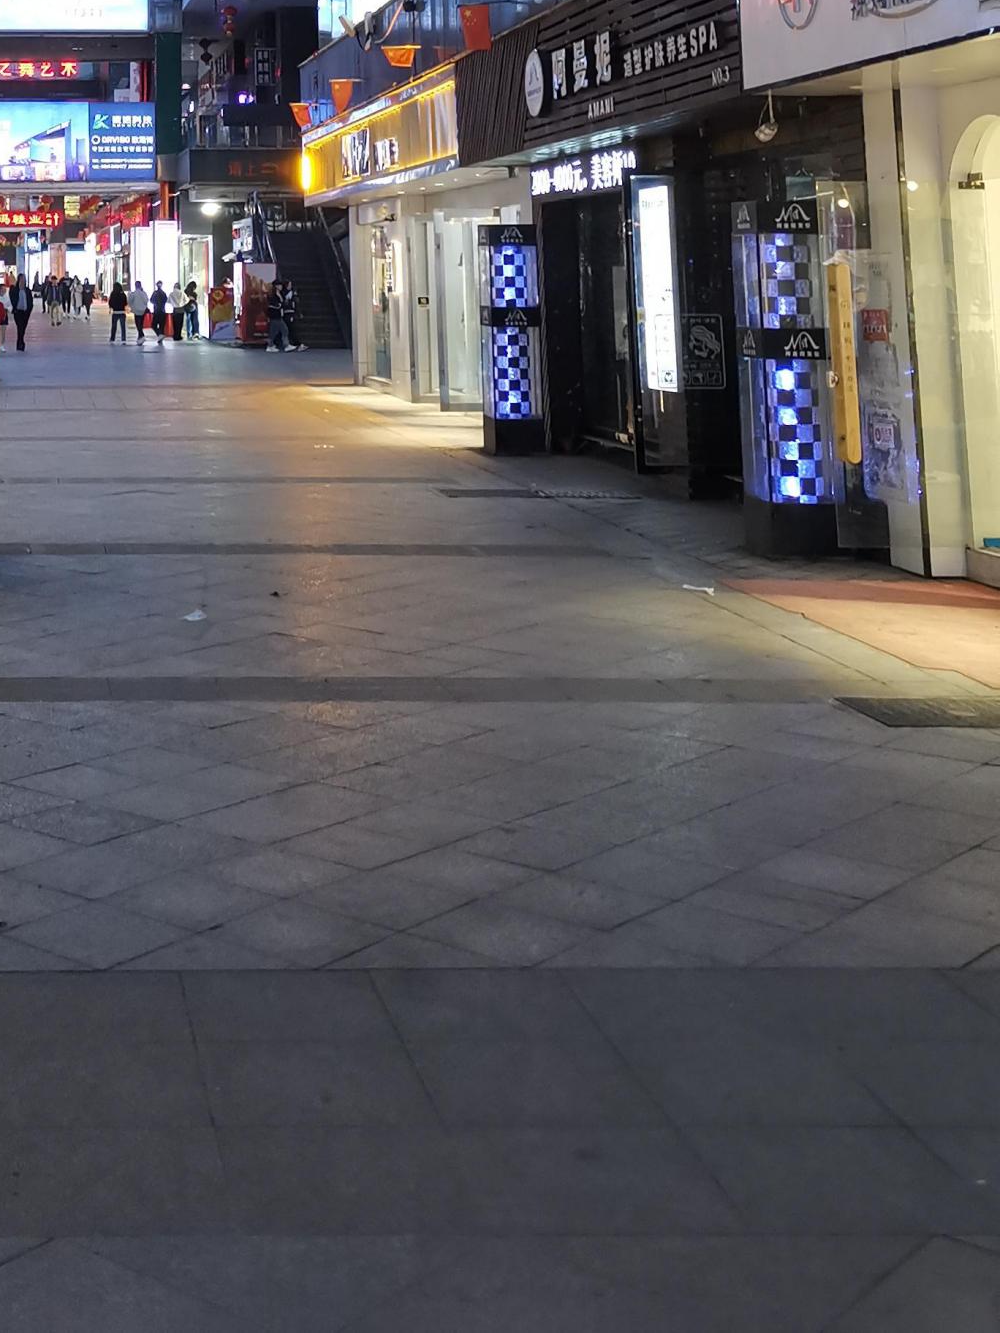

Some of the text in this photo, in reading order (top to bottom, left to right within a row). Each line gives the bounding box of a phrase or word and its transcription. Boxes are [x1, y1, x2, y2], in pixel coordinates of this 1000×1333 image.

[552, 30, 612, 100] 阿曼妮
[587, 97, 615, 119] AMANI
